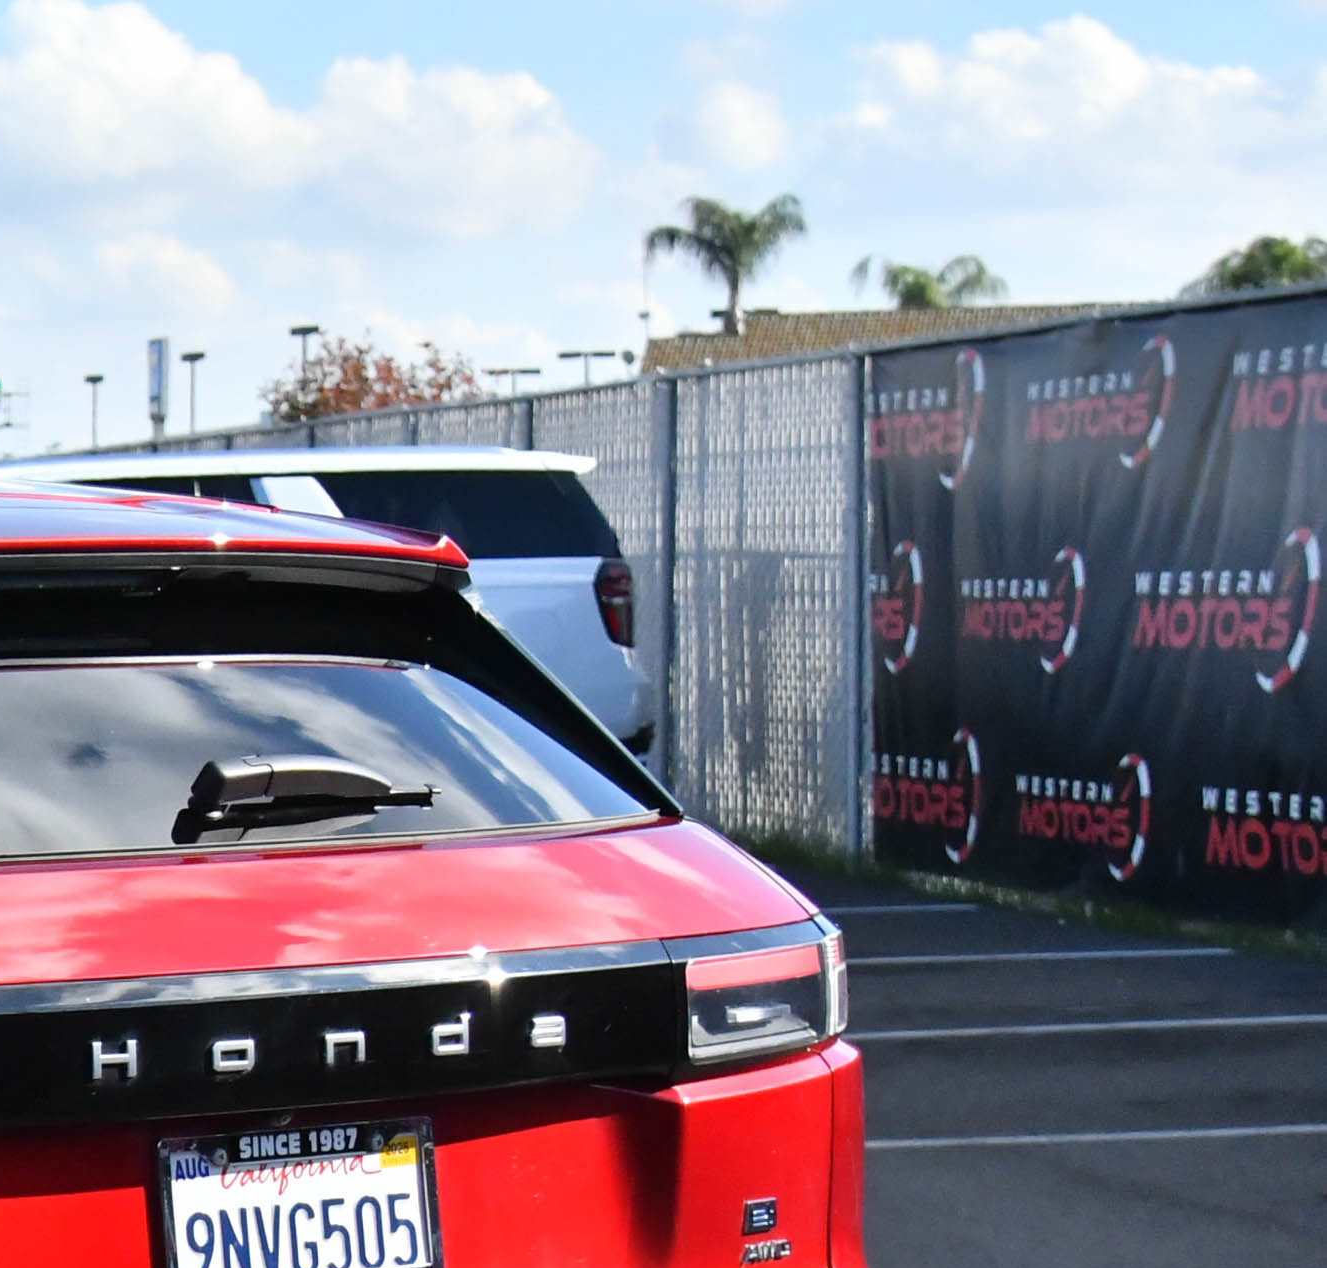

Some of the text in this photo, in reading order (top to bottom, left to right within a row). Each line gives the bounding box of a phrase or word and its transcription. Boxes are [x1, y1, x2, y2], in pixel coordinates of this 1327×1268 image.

[1027, 371, 1132, 400] WESTERN
[1026, 393, 1150, 445] MOTORS
[961, 578, 1049, 598] WESTERN
[1135, 570, 1274, 596] WESTERN
[962, 601, 1066, 640] MOTORS
[1134, 597, 1292, 650] MOTORS
[1016, 774, 1113, 802] WESTERN
[1019, 797, 1131, 848] MOTORS
[1206, 816, 1327, 876] MOTO
[239, 1127, 358, 1159] SINCE 1987
[175, 1157, 210, 1181] AUG
